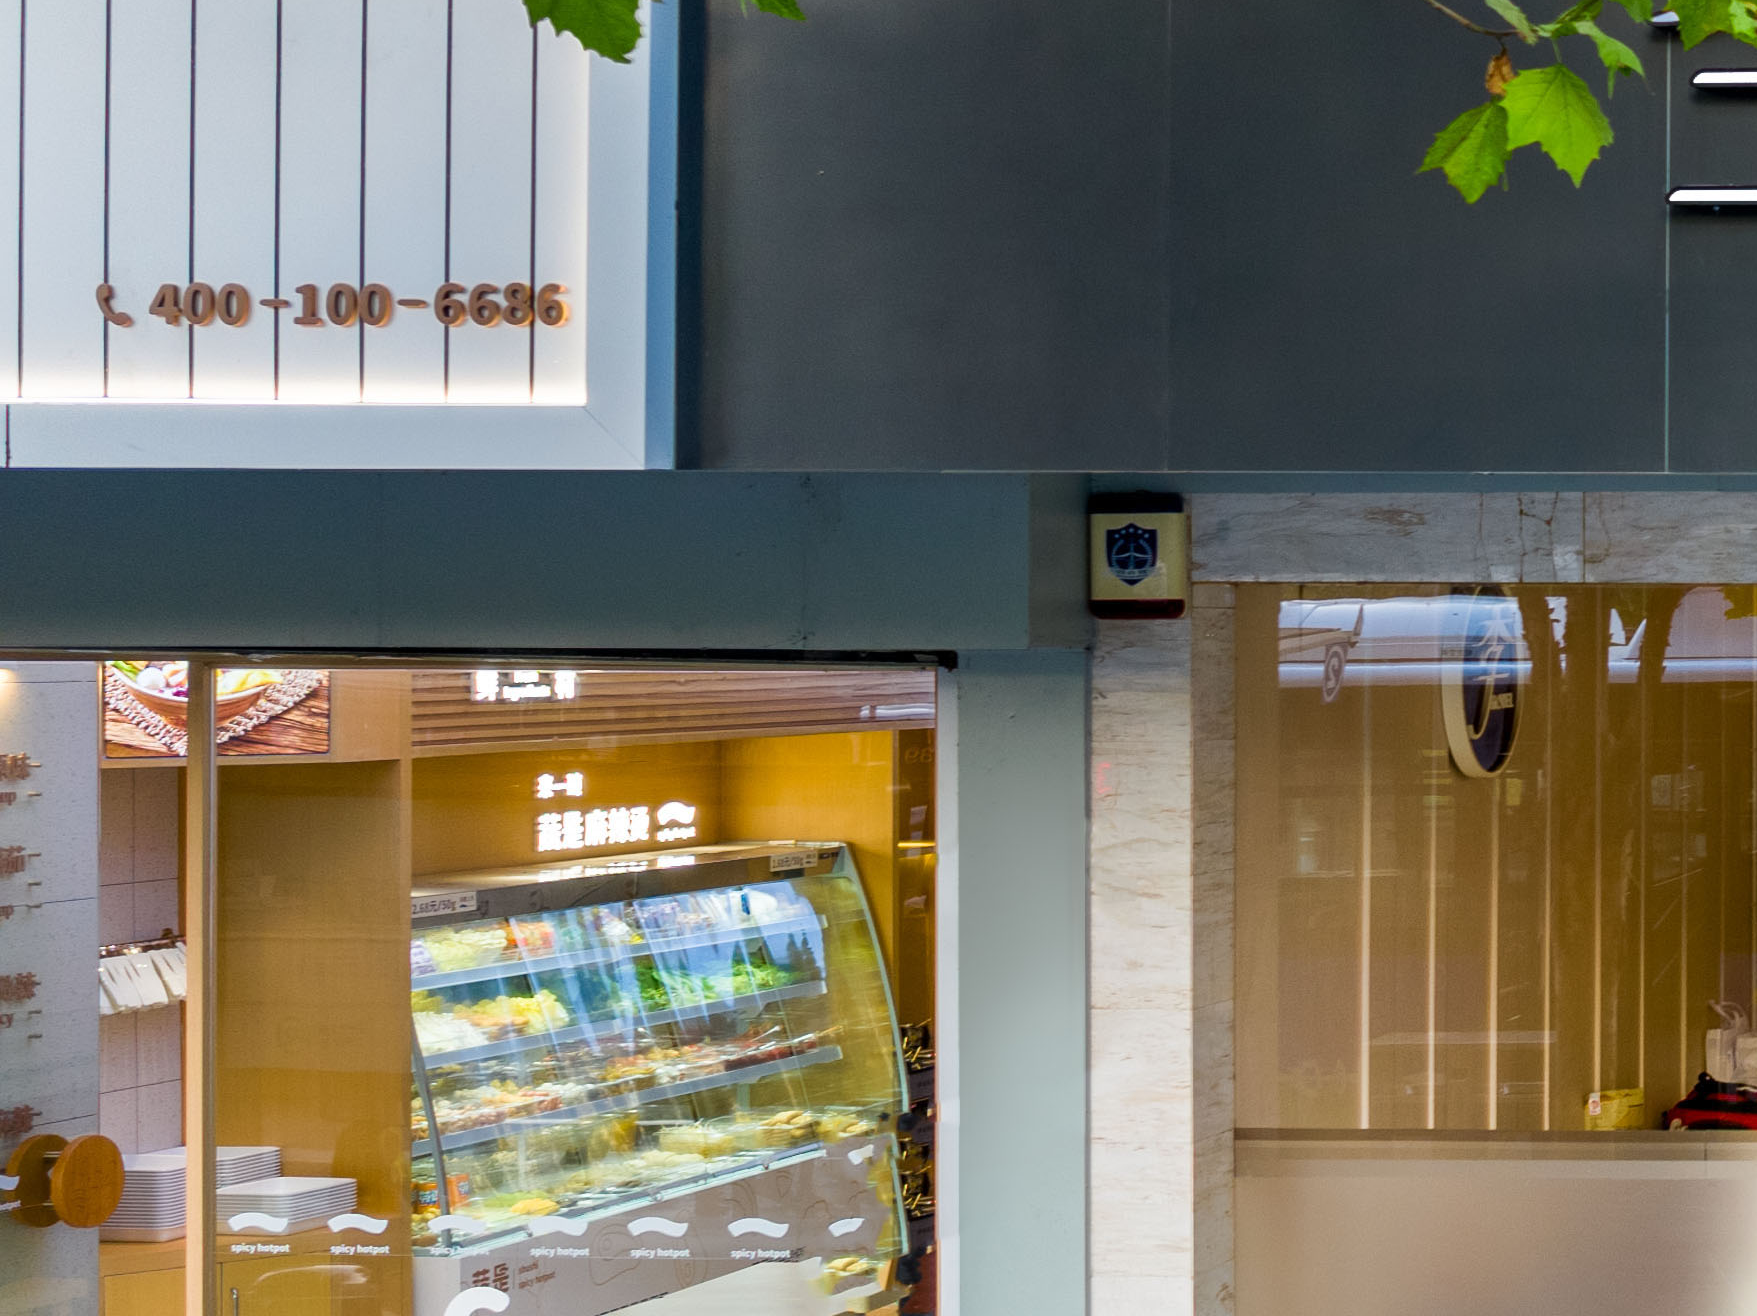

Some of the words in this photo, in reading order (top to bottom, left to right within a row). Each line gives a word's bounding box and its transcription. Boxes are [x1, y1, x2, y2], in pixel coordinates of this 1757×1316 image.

[148, 282, 571, 328] 400-100-6686
[530, 1247, 556, 1258] spicy
[557, 1247, 590, 1258] hotpot
[630, 1247, 656, 1259] spicy
[657, 1247, 690, 1259] hotpot
[730, 1247, 756, 1259] spicy
[757, 1247, 791, 1259] hotpot
